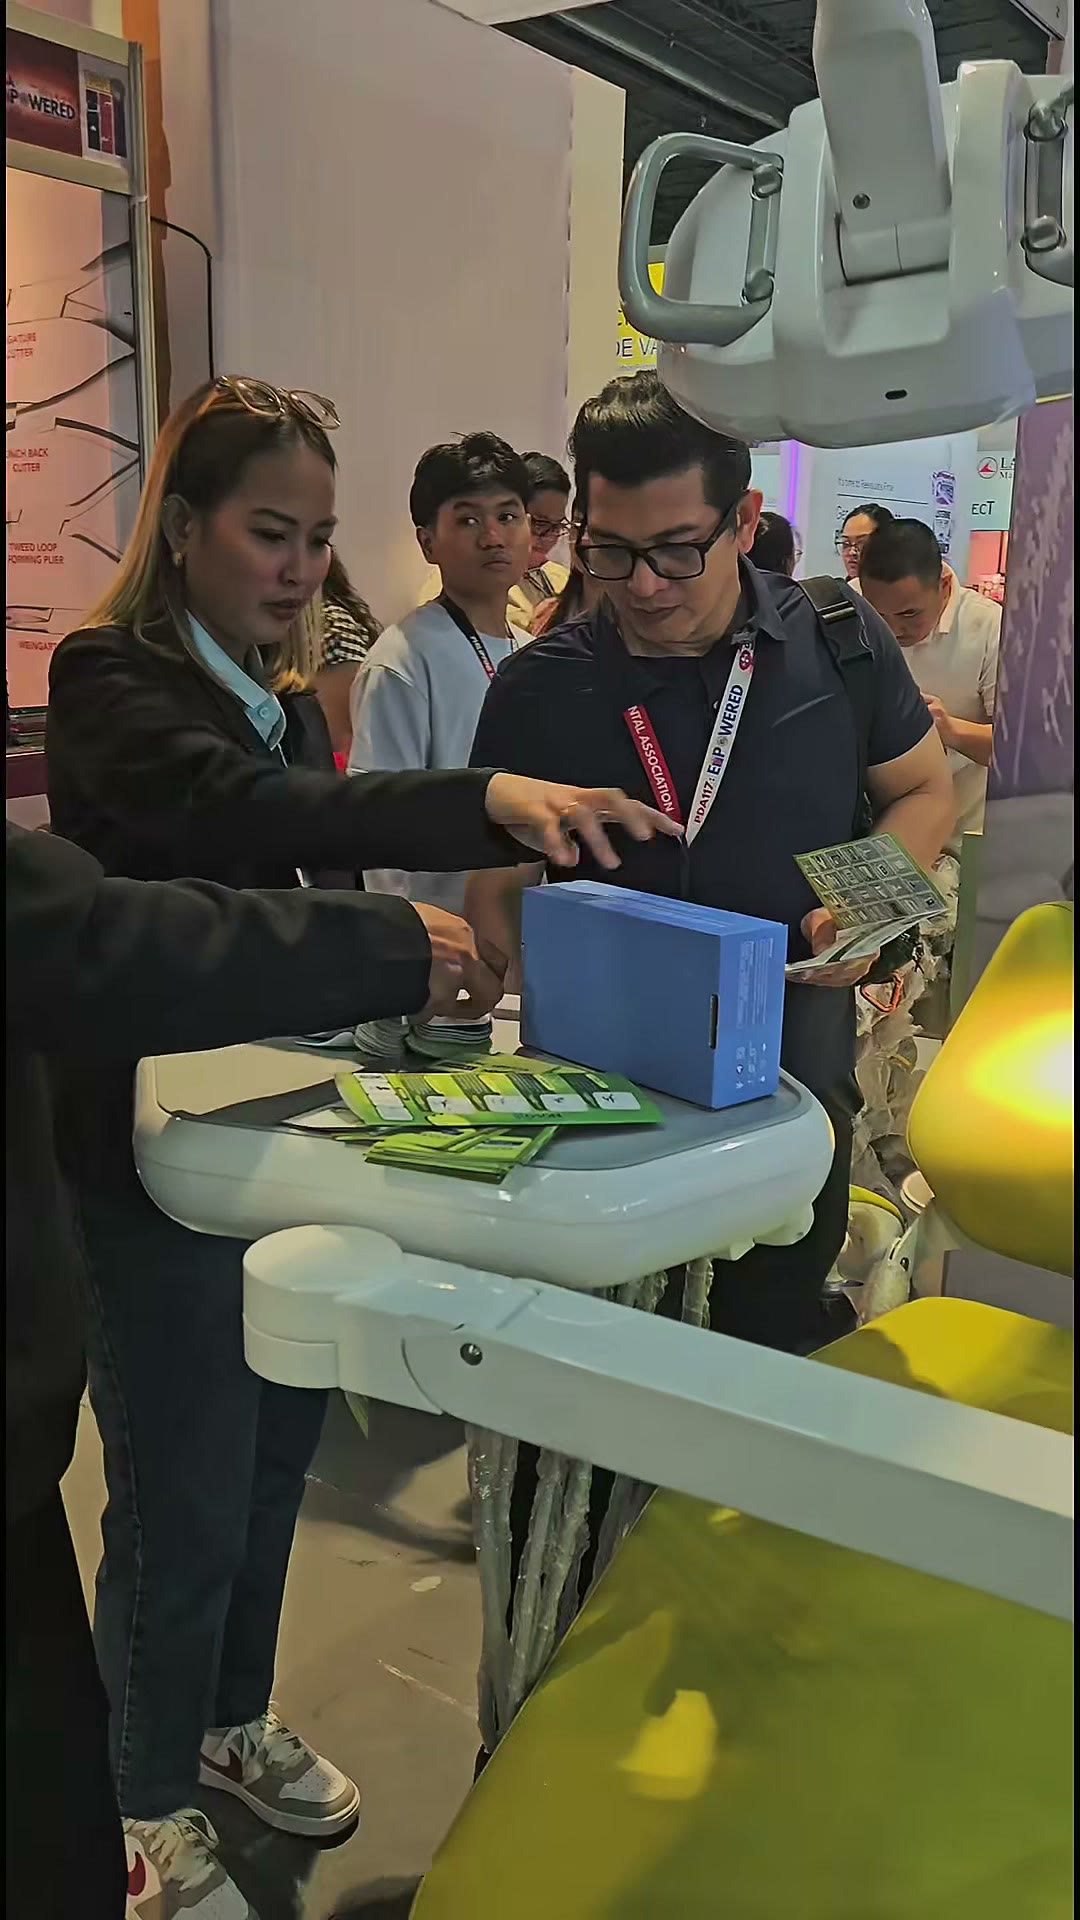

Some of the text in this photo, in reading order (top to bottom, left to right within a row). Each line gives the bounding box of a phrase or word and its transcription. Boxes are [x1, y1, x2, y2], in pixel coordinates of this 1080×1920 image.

[13, 462, 41, 472] CUTTER
[8, 542, 57, 552] TWEED LOOP
[43, 555, 65, 565] PLIER
[639, 734, 676, 813] ASSOCIATION
